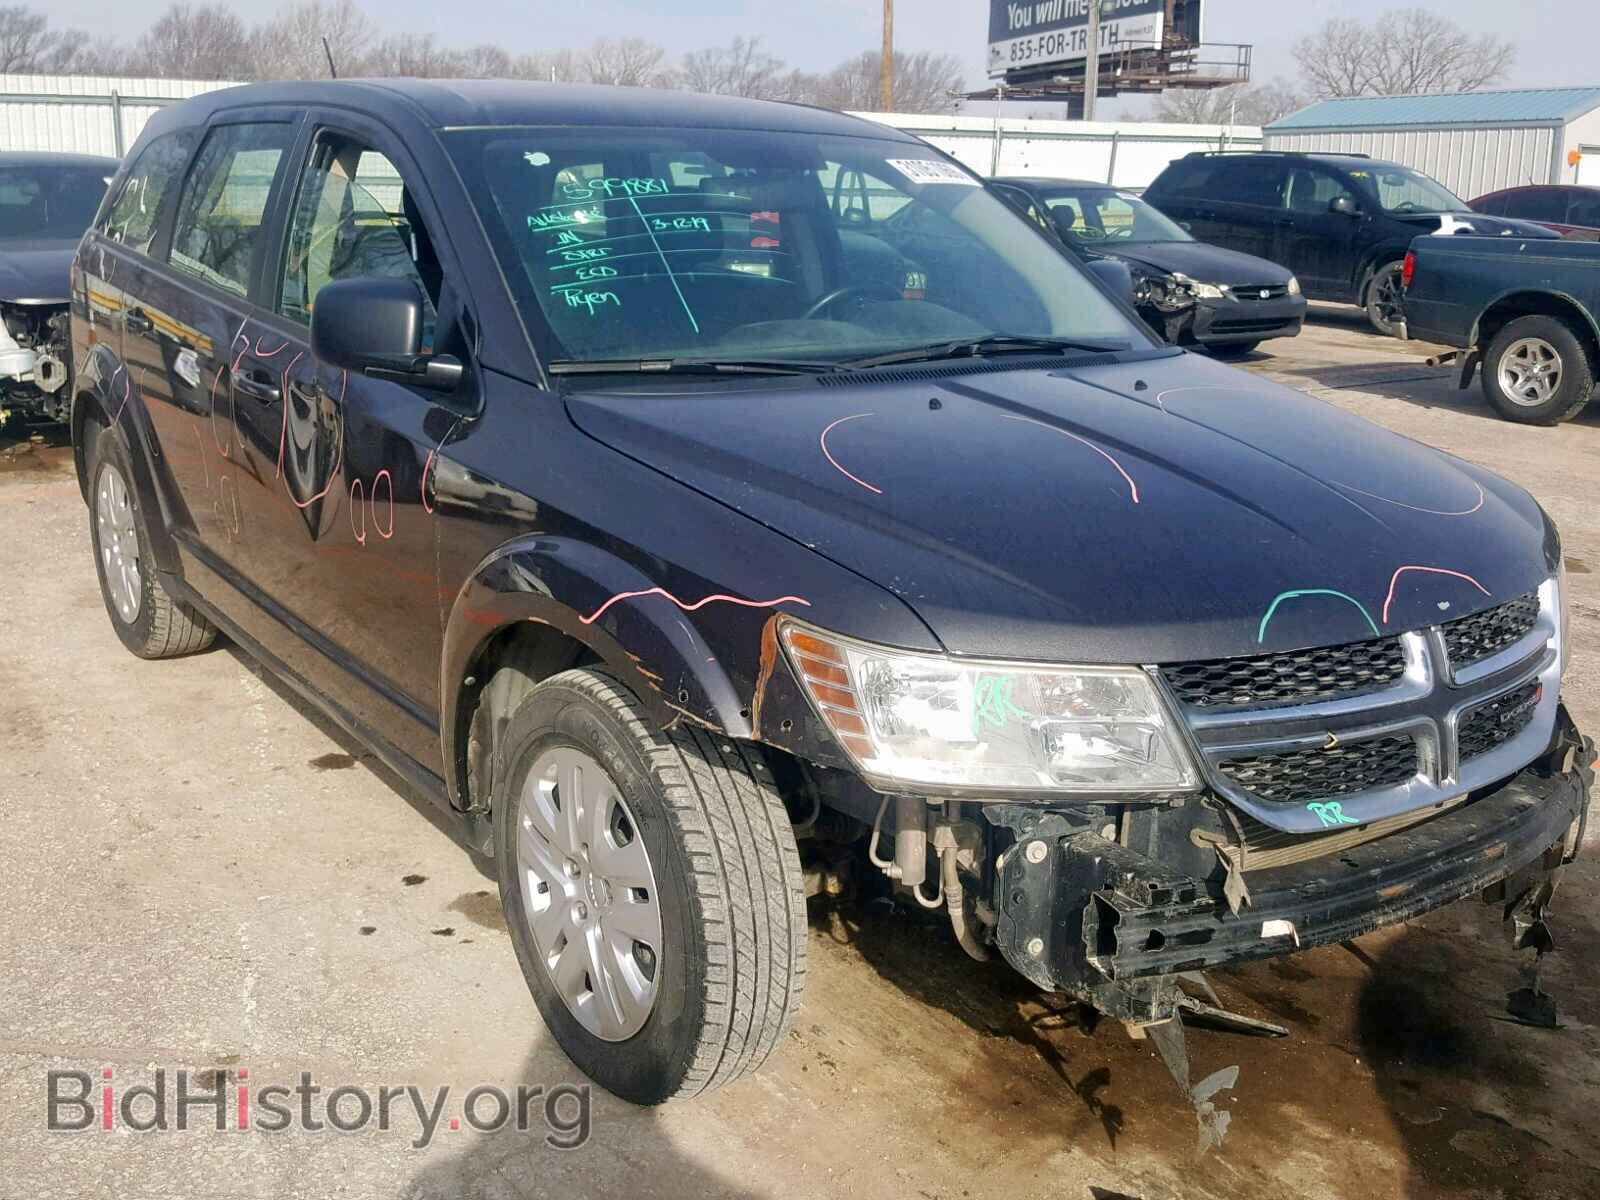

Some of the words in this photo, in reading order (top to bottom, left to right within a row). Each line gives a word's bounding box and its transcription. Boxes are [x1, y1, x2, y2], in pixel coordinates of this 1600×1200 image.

[1007, 2, 1032, 30] You
[1036, 0, 1062, 24] will
[1010, 24, 1119, 61] 855-FOR-TRTH
[1307, 801, 1360, 827] RR
